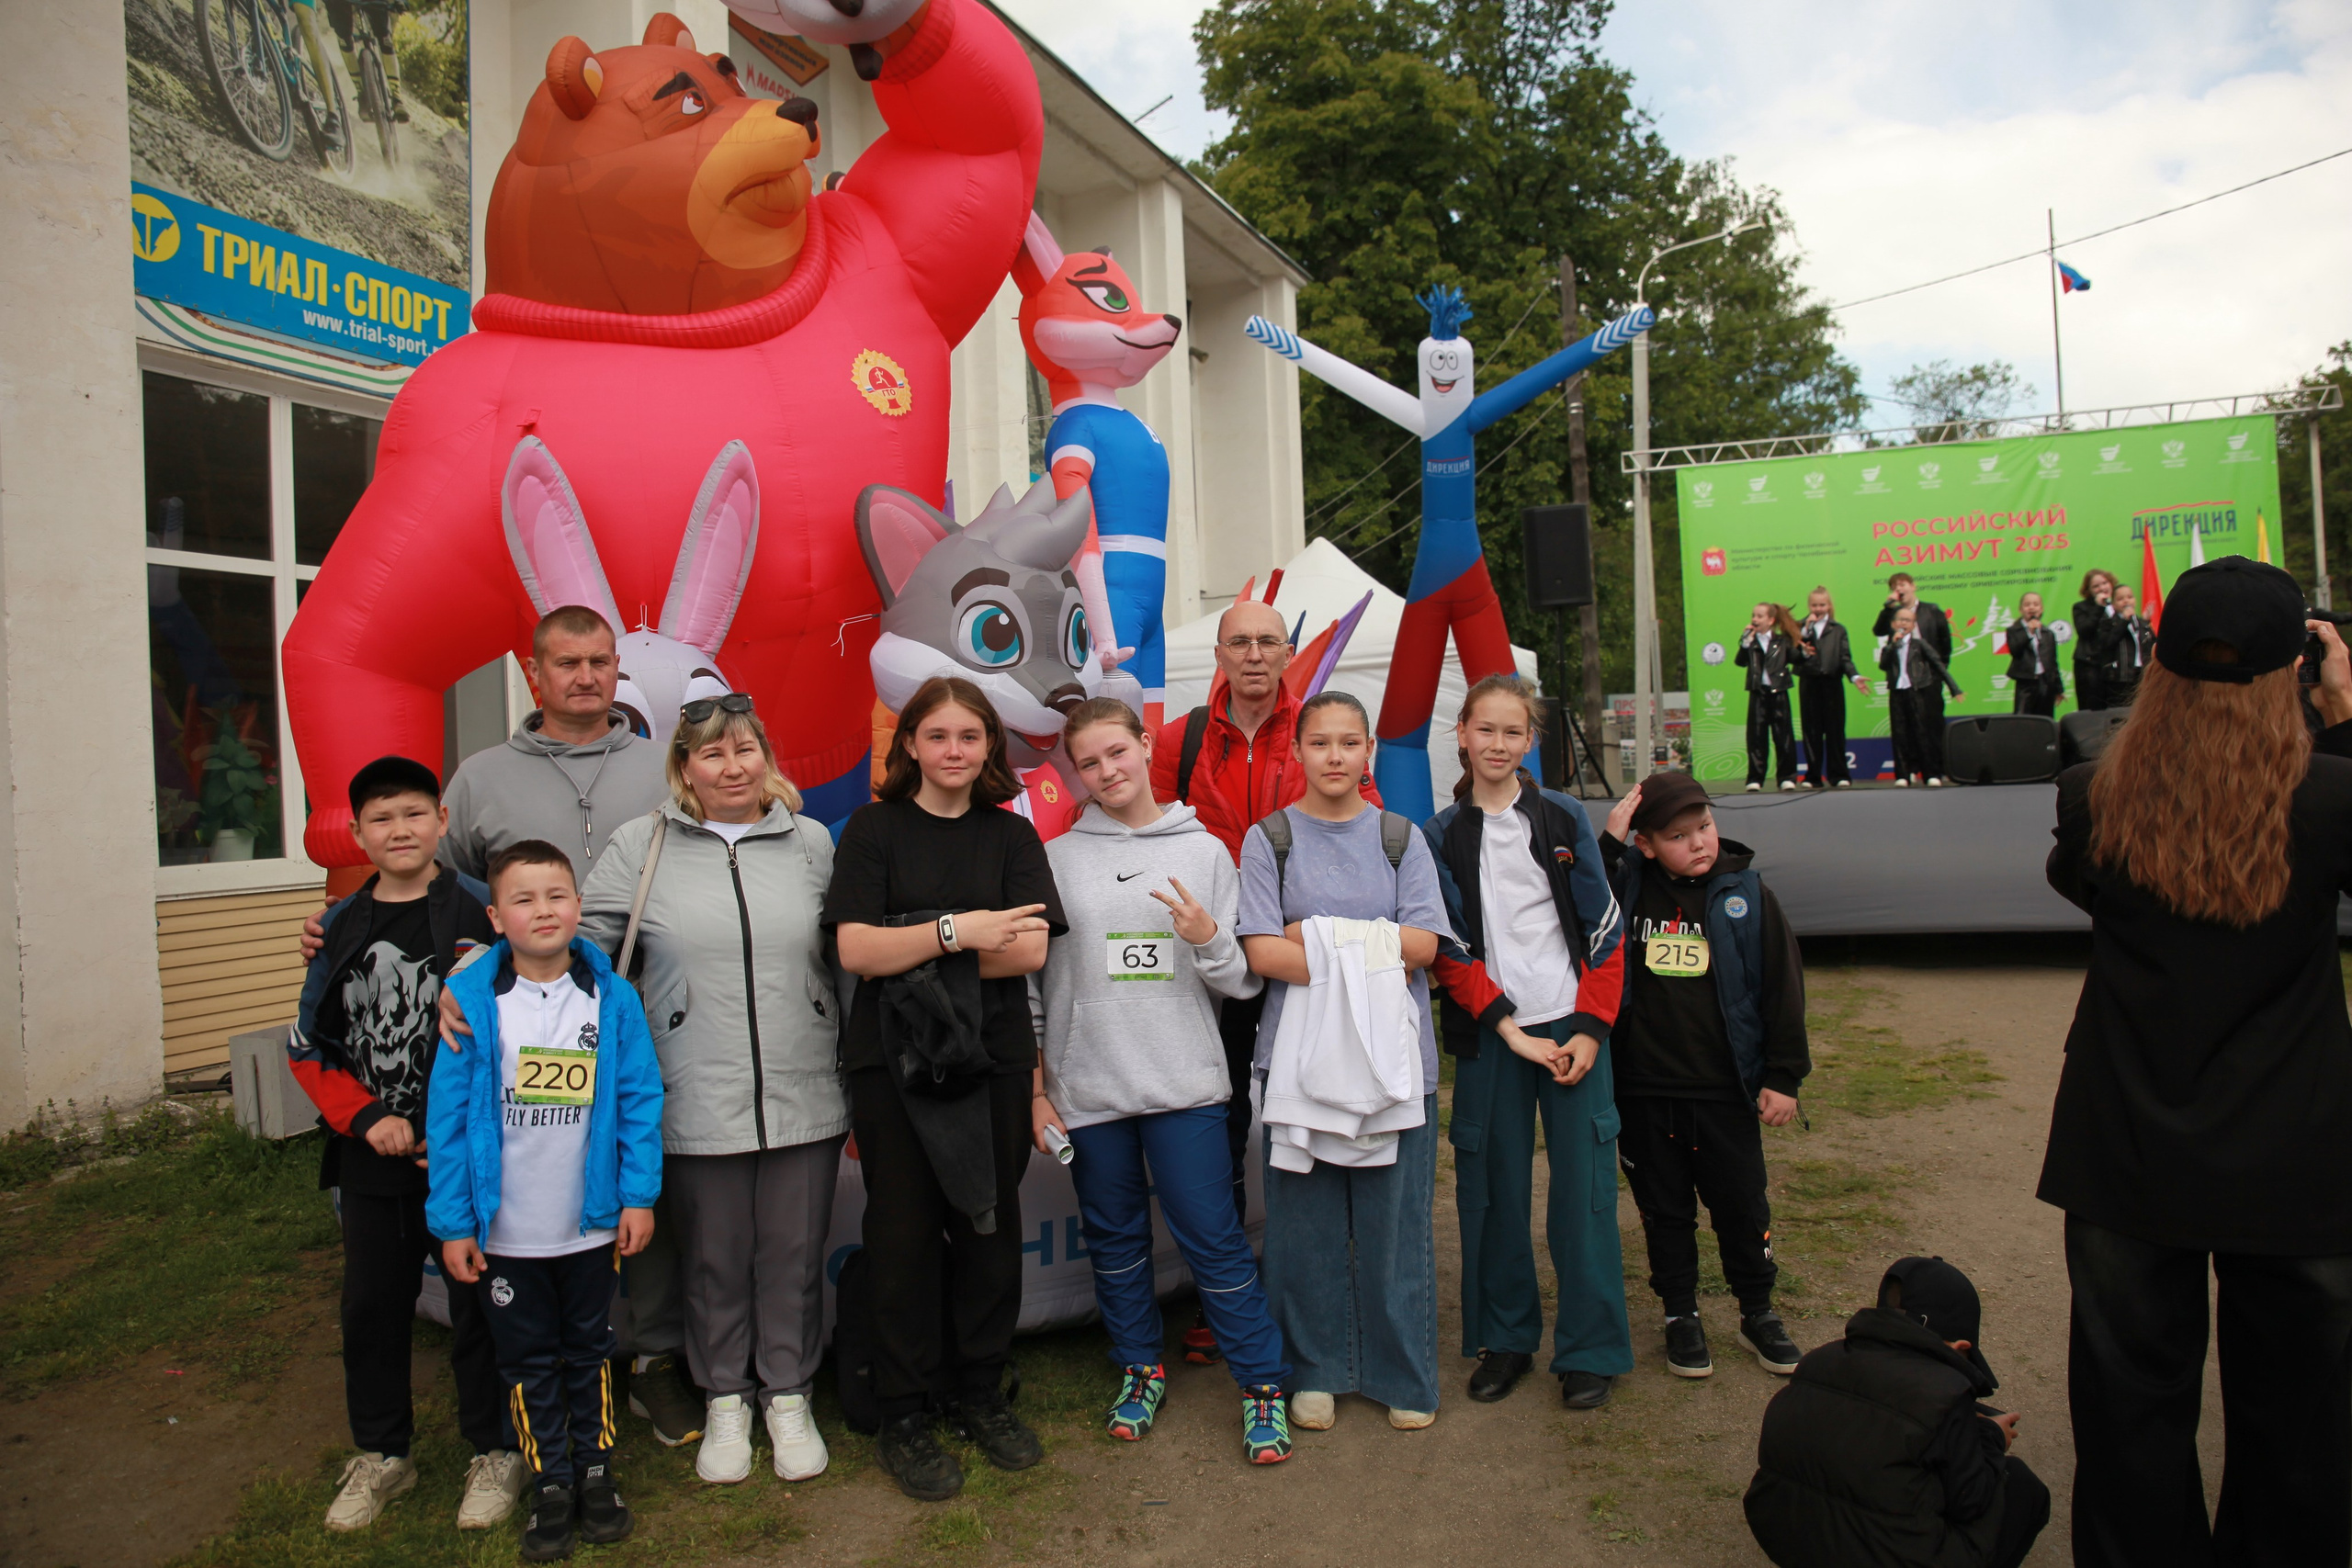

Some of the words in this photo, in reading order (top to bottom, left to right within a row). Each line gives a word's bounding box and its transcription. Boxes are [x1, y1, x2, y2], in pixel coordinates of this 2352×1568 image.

[756, 72, 800, 101] MADS
[302, 309, 441, 356] www.trial-sport.
[882, 389, 896, 397] ГТО
[1426, 459, 1470, 474] ДИРЕКЦИЯ
[1872, 503, 2067, 540] РОССИЙСКИЙ
[2131, 509, 2237, 541] ДИРЕКЦИЯ
[1874, 538, 2004, 568] АЗИМУТ
[2014, 533, 2070, 553] 2025
[1123, 944, 1159, 968] 63
[1655, 943, 1700, 967] 215
[522, 1061, 588, 1091] 220
[505, 1107, 526, 1126] FLY
[531, 1105, 581, 1126] BETTER
